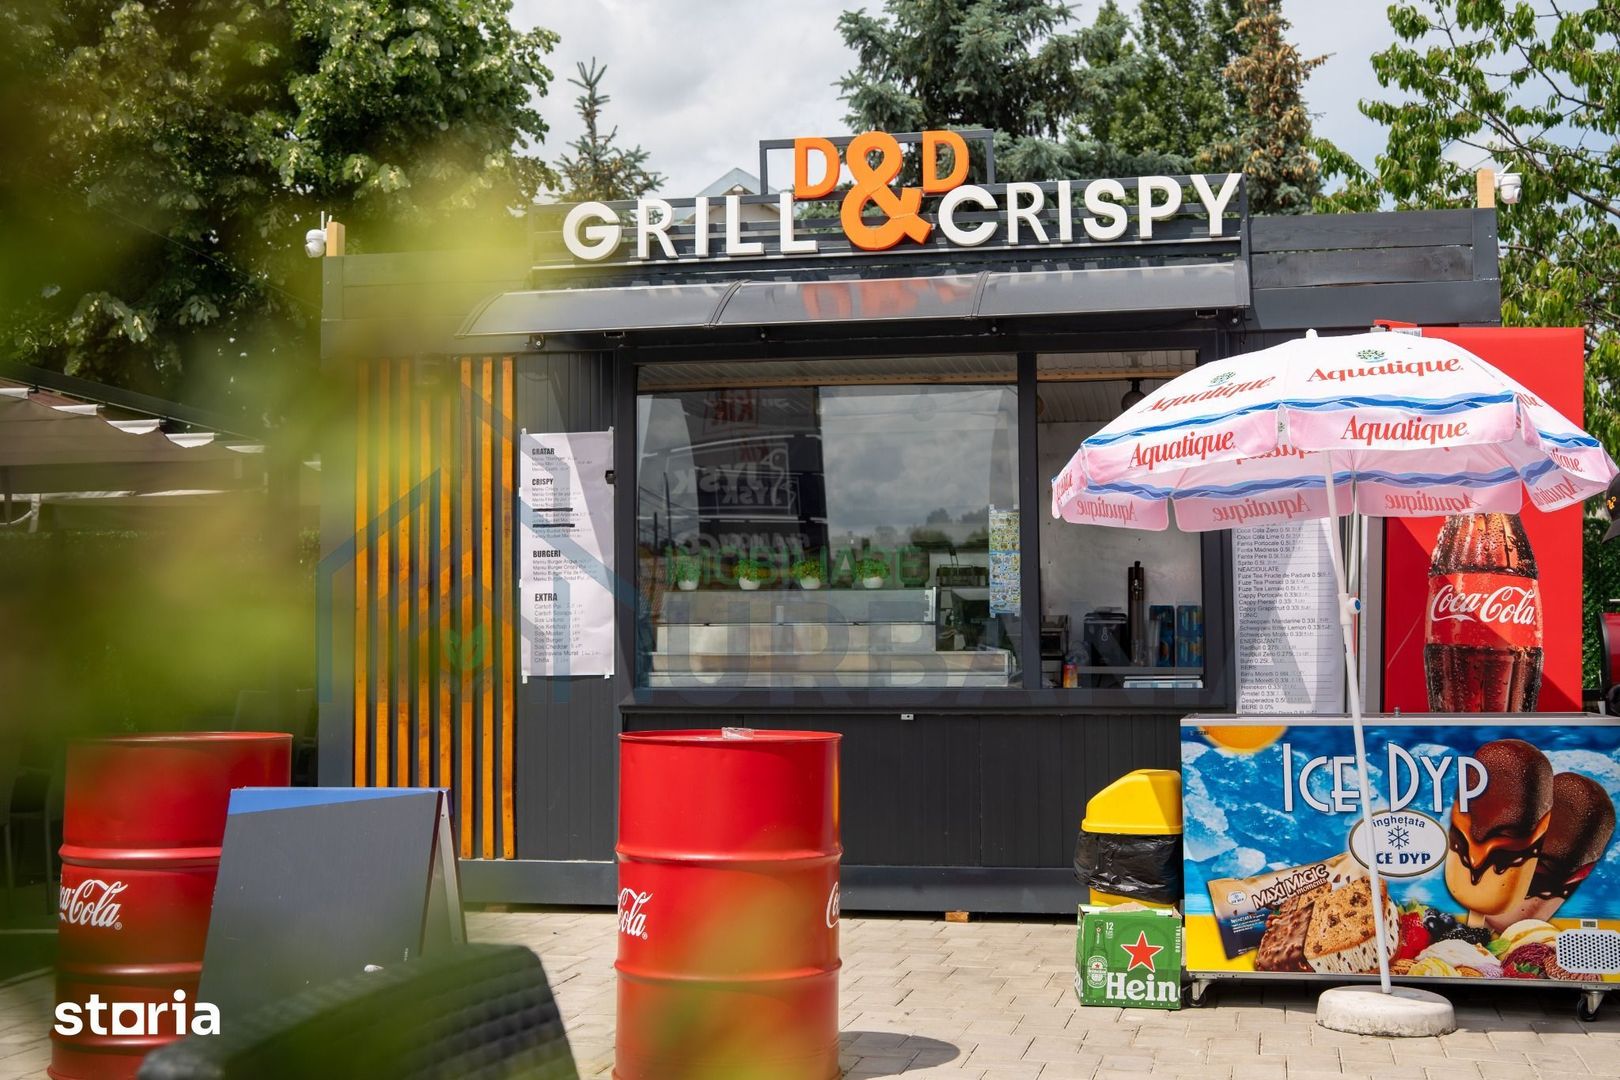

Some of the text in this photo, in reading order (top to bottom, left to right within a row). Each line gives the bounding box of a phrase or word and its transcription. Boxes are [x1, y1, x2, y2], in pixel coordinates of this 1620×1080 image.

[562, 172, 1244, 260] GRILL CRISPY
[1306, 356, 1463, 382] Aquatique
[1138, 376, 1276, 413] Aquatique
[1340, 415, 1469, 446] Aquatique
[1128, 431, 1236, 470] Aquatique
[533, 550, 561, 558] BURGERI
[535, 593, 558, 602] EXTRA
[1430, 584, 1536, 625] Coca-Cola
[1282, 742, 1489, 814] ICE DYP
[1399, 852, 1431, 865] DYP
[1251, 863, 1330, 910] MAXI MAGIC
[1296, 879, 1328, 896] moments
[1105, 921, 1114, 931] 12
[1106, 972, 1181, 1003] Hein
